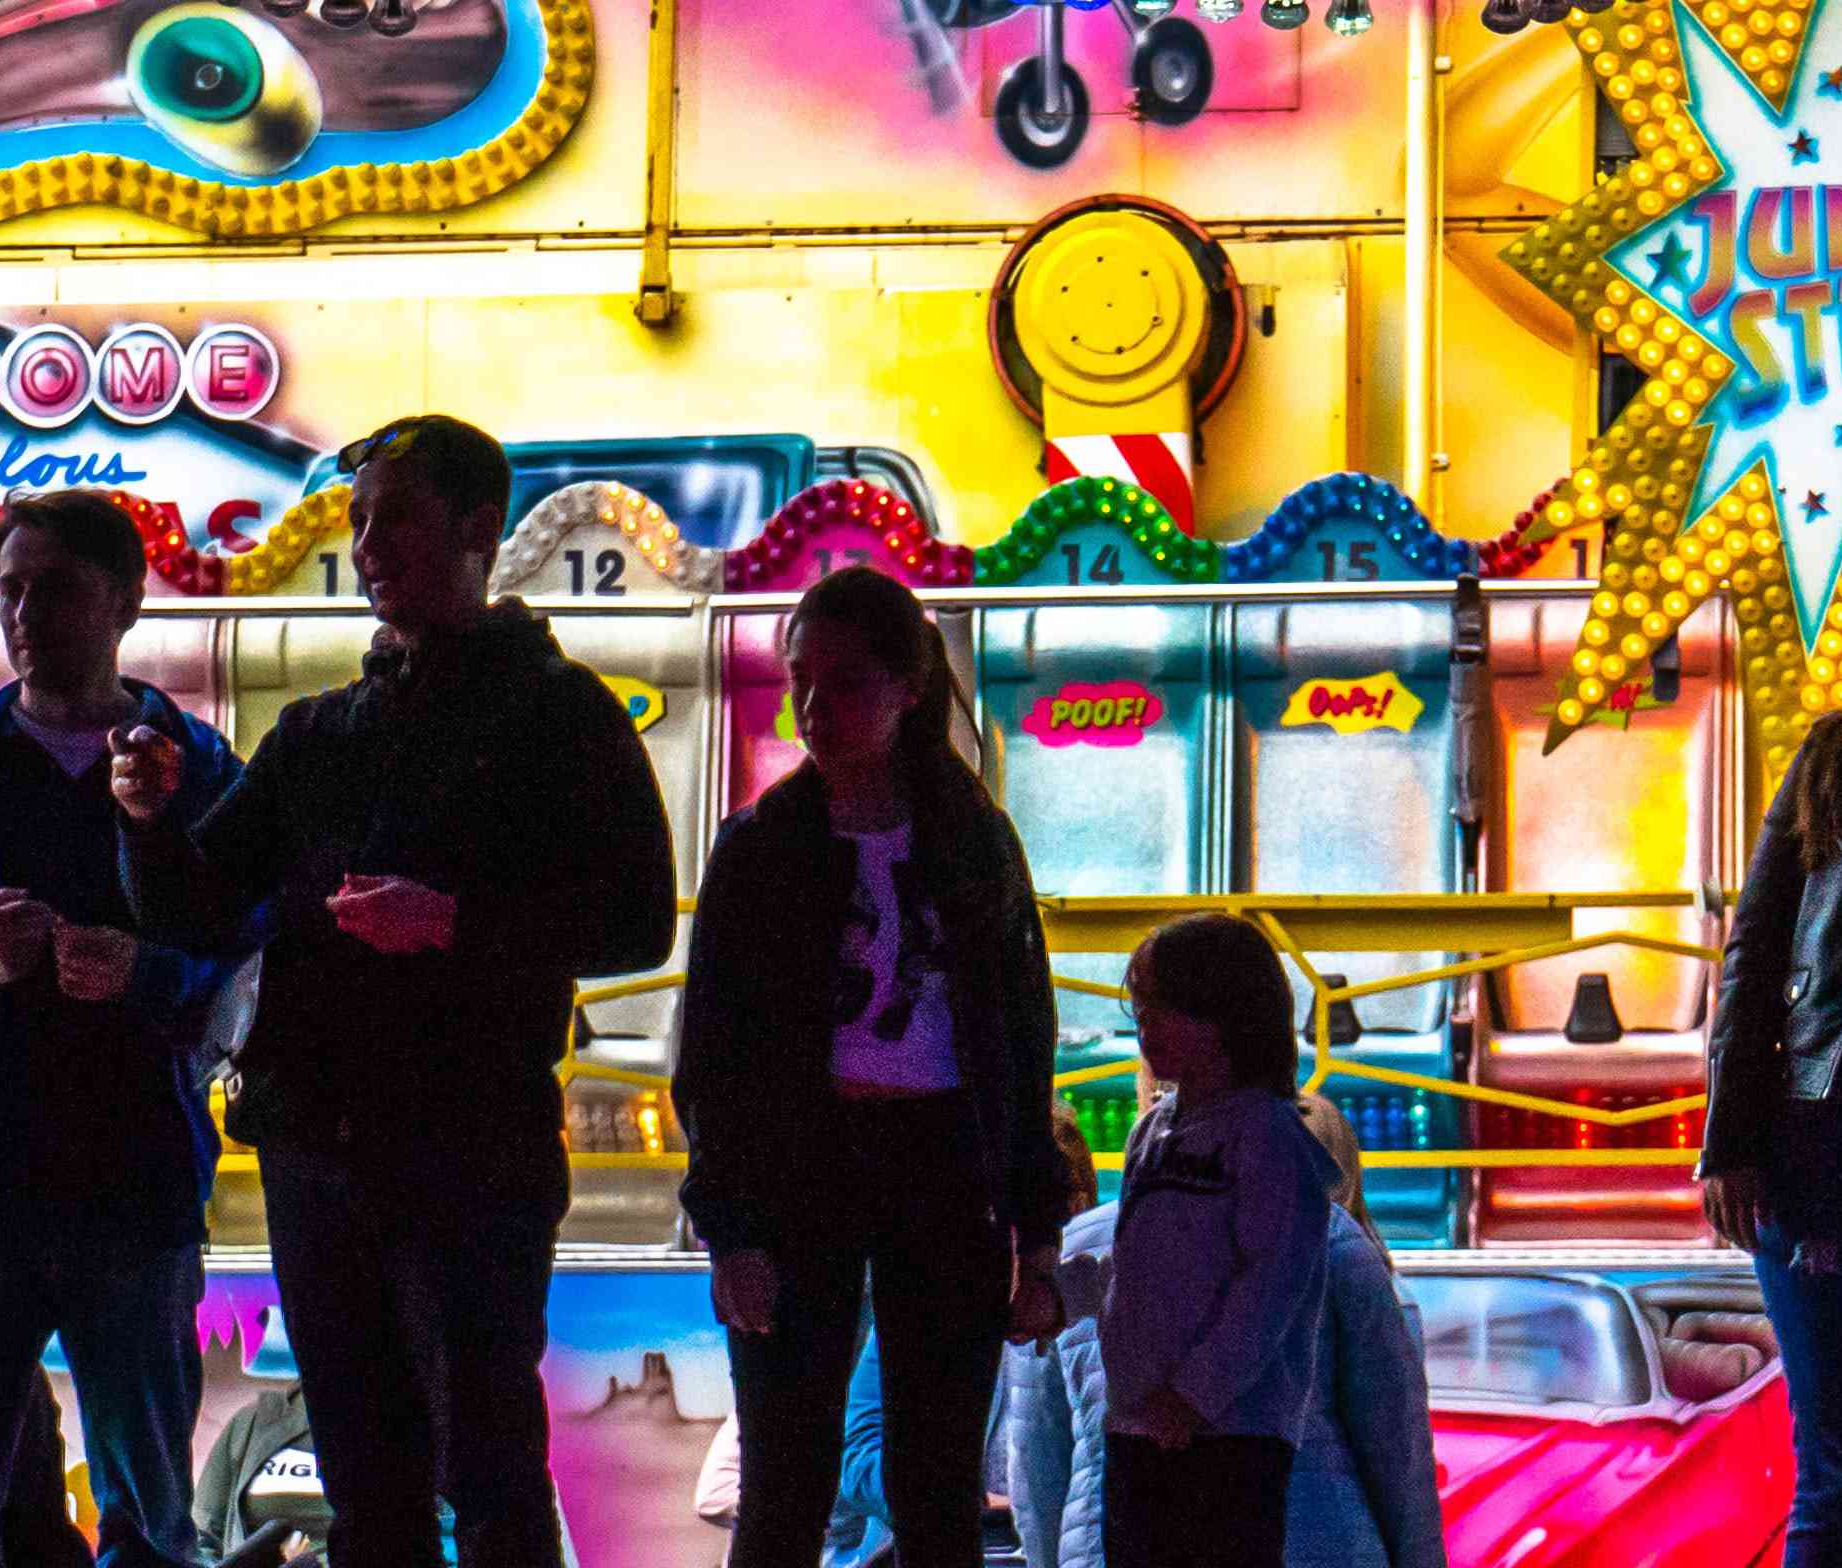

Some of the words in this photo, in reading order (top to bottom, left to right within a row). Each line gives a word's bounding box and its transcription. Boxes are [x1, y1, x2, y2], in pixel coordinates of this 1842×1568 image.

[564, 549, 626, 597] 12
[1061, 543, 1124, 586] 14
[1316, 538, 1380, 582] 15
[1050, 697, 1148, 729] POOF!
